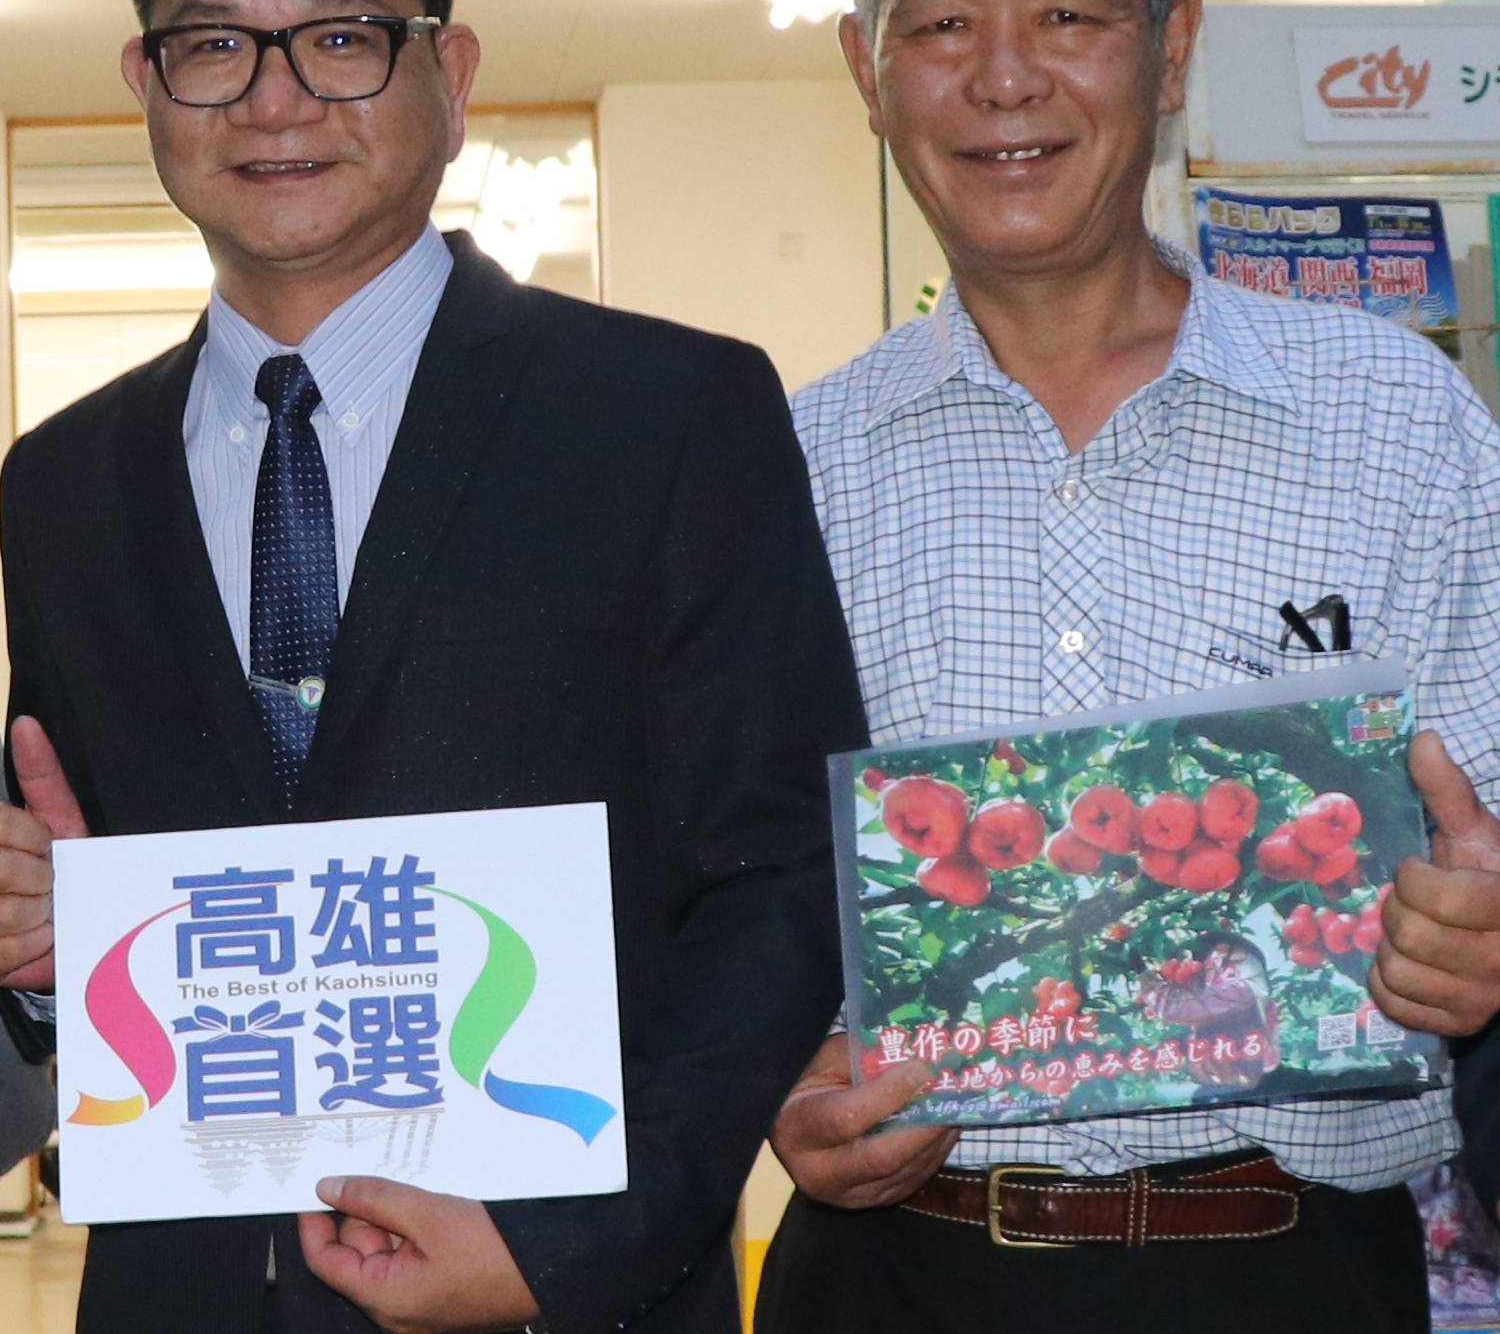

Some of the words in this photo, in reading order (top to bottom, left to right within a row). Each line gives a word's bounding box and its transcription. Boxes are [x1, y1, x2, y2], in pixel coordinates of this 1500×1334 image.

[1317, 45, 1431, 108] City
[1296, 255, 1360, 297] 関西
[1368, 255, 1428, 297] 福岡
[171, 853, 439, 979] 高雄
[177, 983, 220, 1000] The
[227, 980, 279, 996] Best
[286, 976, 309, 993] of
[315, 970, 439, 992] Kaohsiung
[171, 994, 445, 1123] 首選
[878, 1014, 1099, 1065] 豊作の季節に
[920, 1033, 1264, 1093] 土地からの恵みを感じれる
